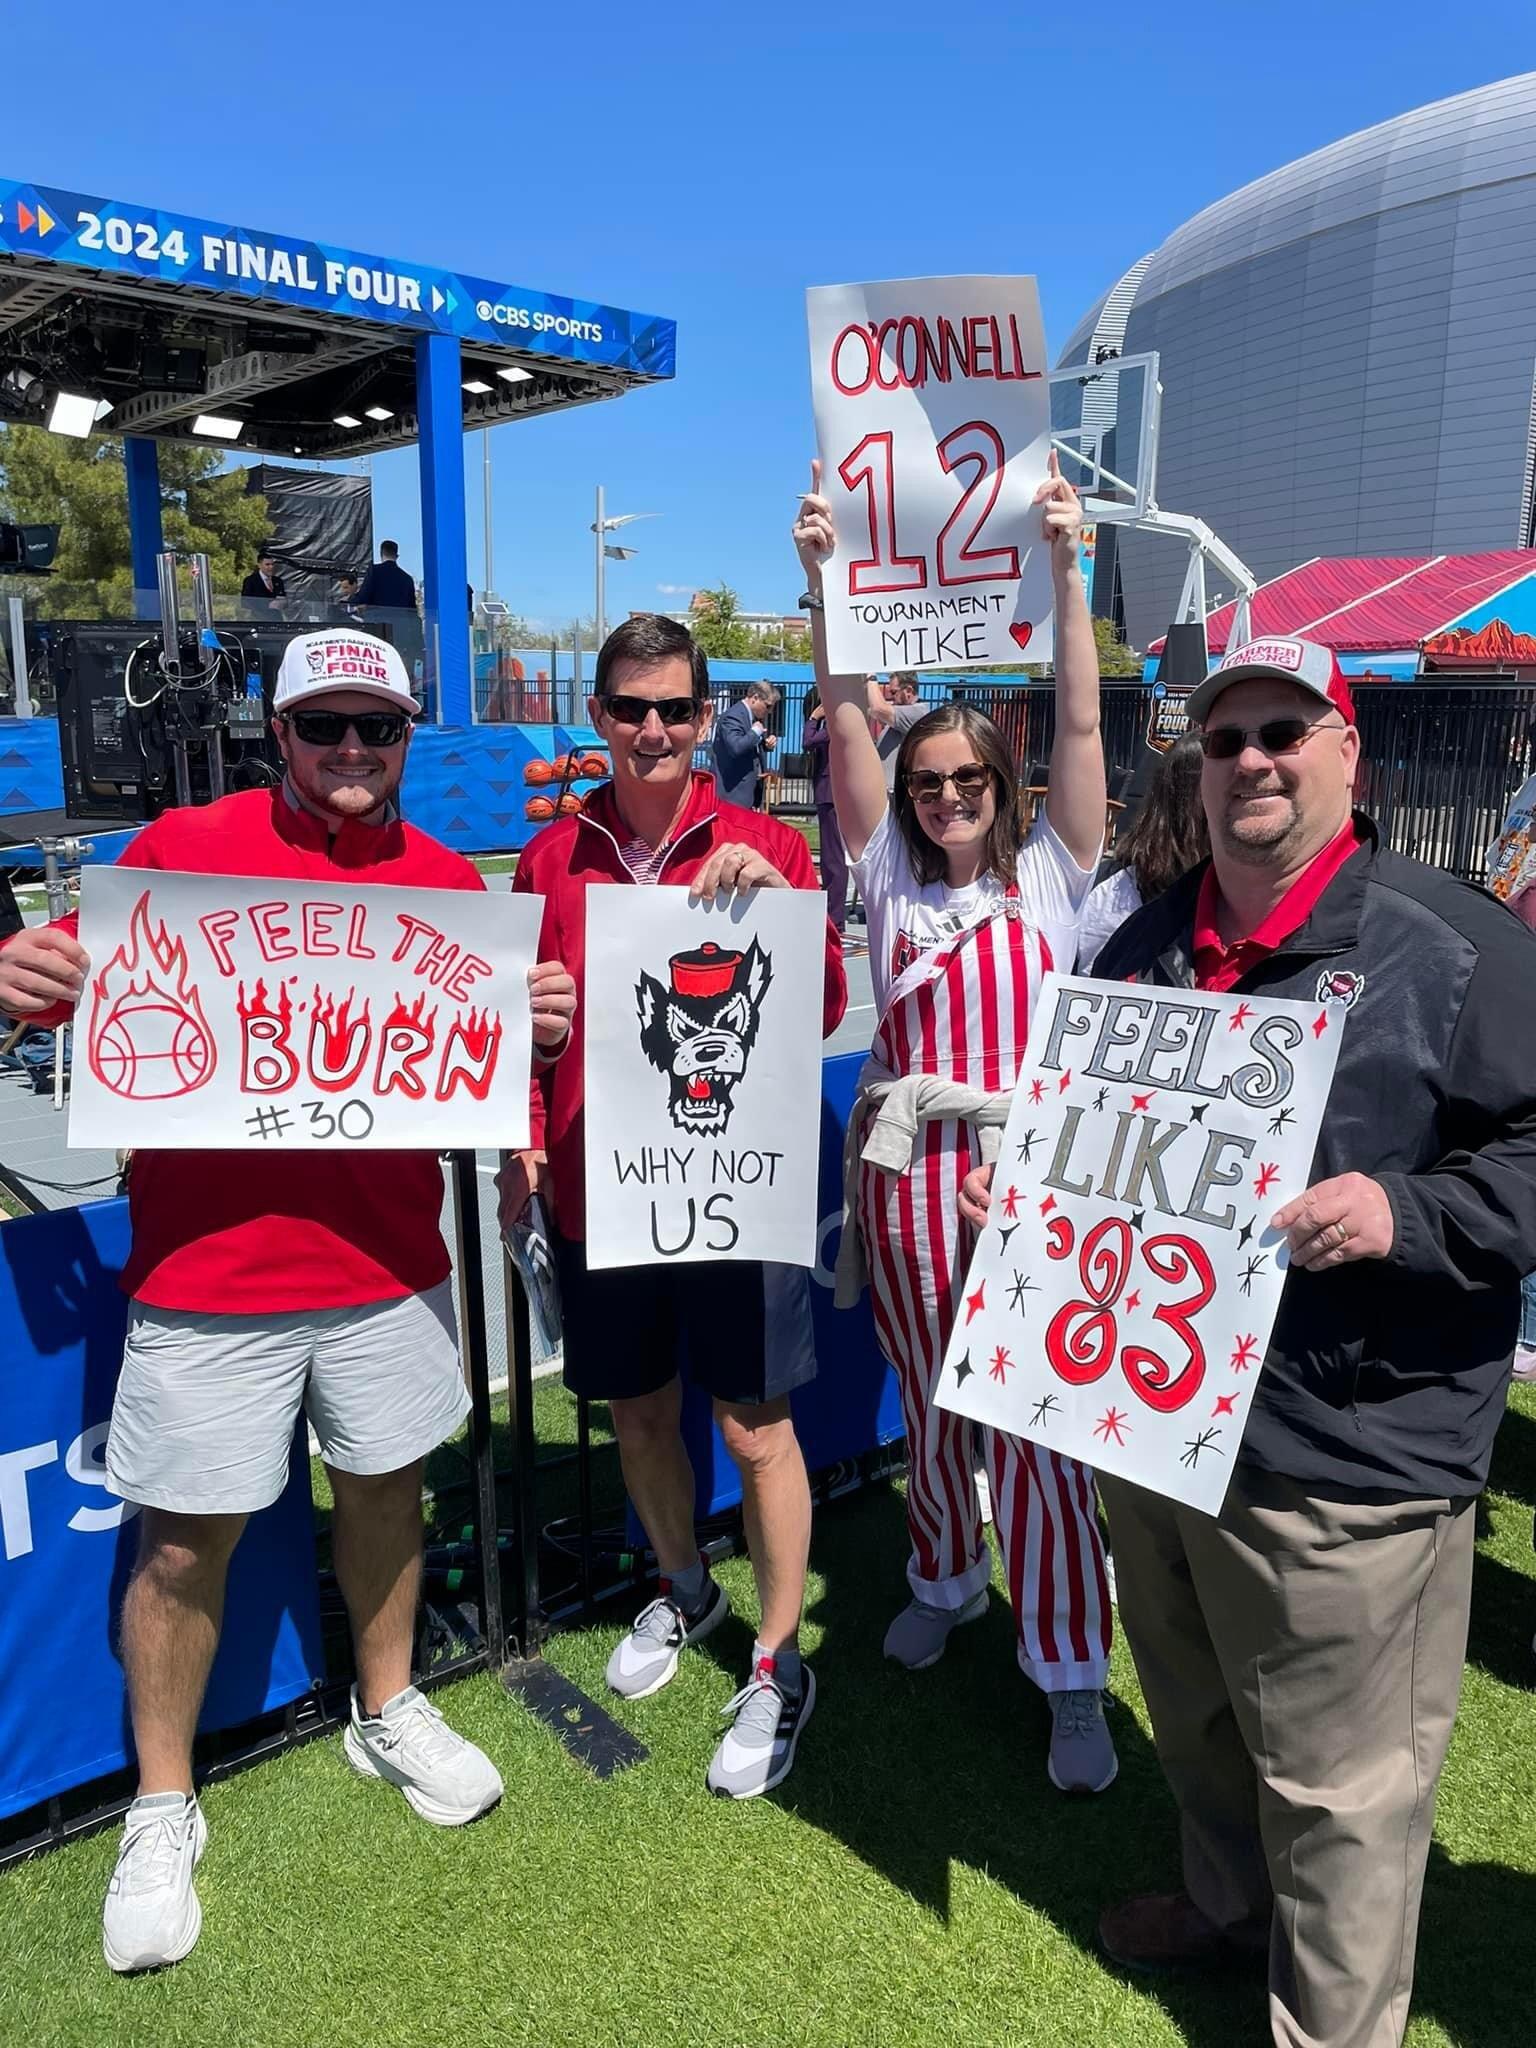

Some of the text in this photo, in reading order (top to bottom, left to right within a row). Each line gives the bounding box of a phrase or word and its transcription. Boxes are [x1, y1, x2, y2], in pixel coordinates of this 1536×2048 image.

[76, 211, 422, 312] 2024 FINAL FOUR
[494, 303, 603, 342] CBS SPORTS
[832, 312, 1042, 397] O'CONNELL
[838, 420, 1022, 596] 12
[849, 594, 1006, 624] TOURNAMENT
[326, 645, 386, 663] FINAL
[881, 622, 990, 666] MIKE
[327, 662, 387, 680] FOUR
[1156, 714, 1190, 731] FOUR
[1157, 699, 1187, 715] FINA
[198, 901, 494, 1003] FEEL THE
[239, 1008, 501, 1102] BURN
[1038, 987, 1305, 1109] FEELS
[244, 1098, 375, 1140] #30
[614, 1146, 785, 1187] WHY NOT
[1041, 1104, 1257, 1231] LIKE
[651, 1192, 740, 1257] US
